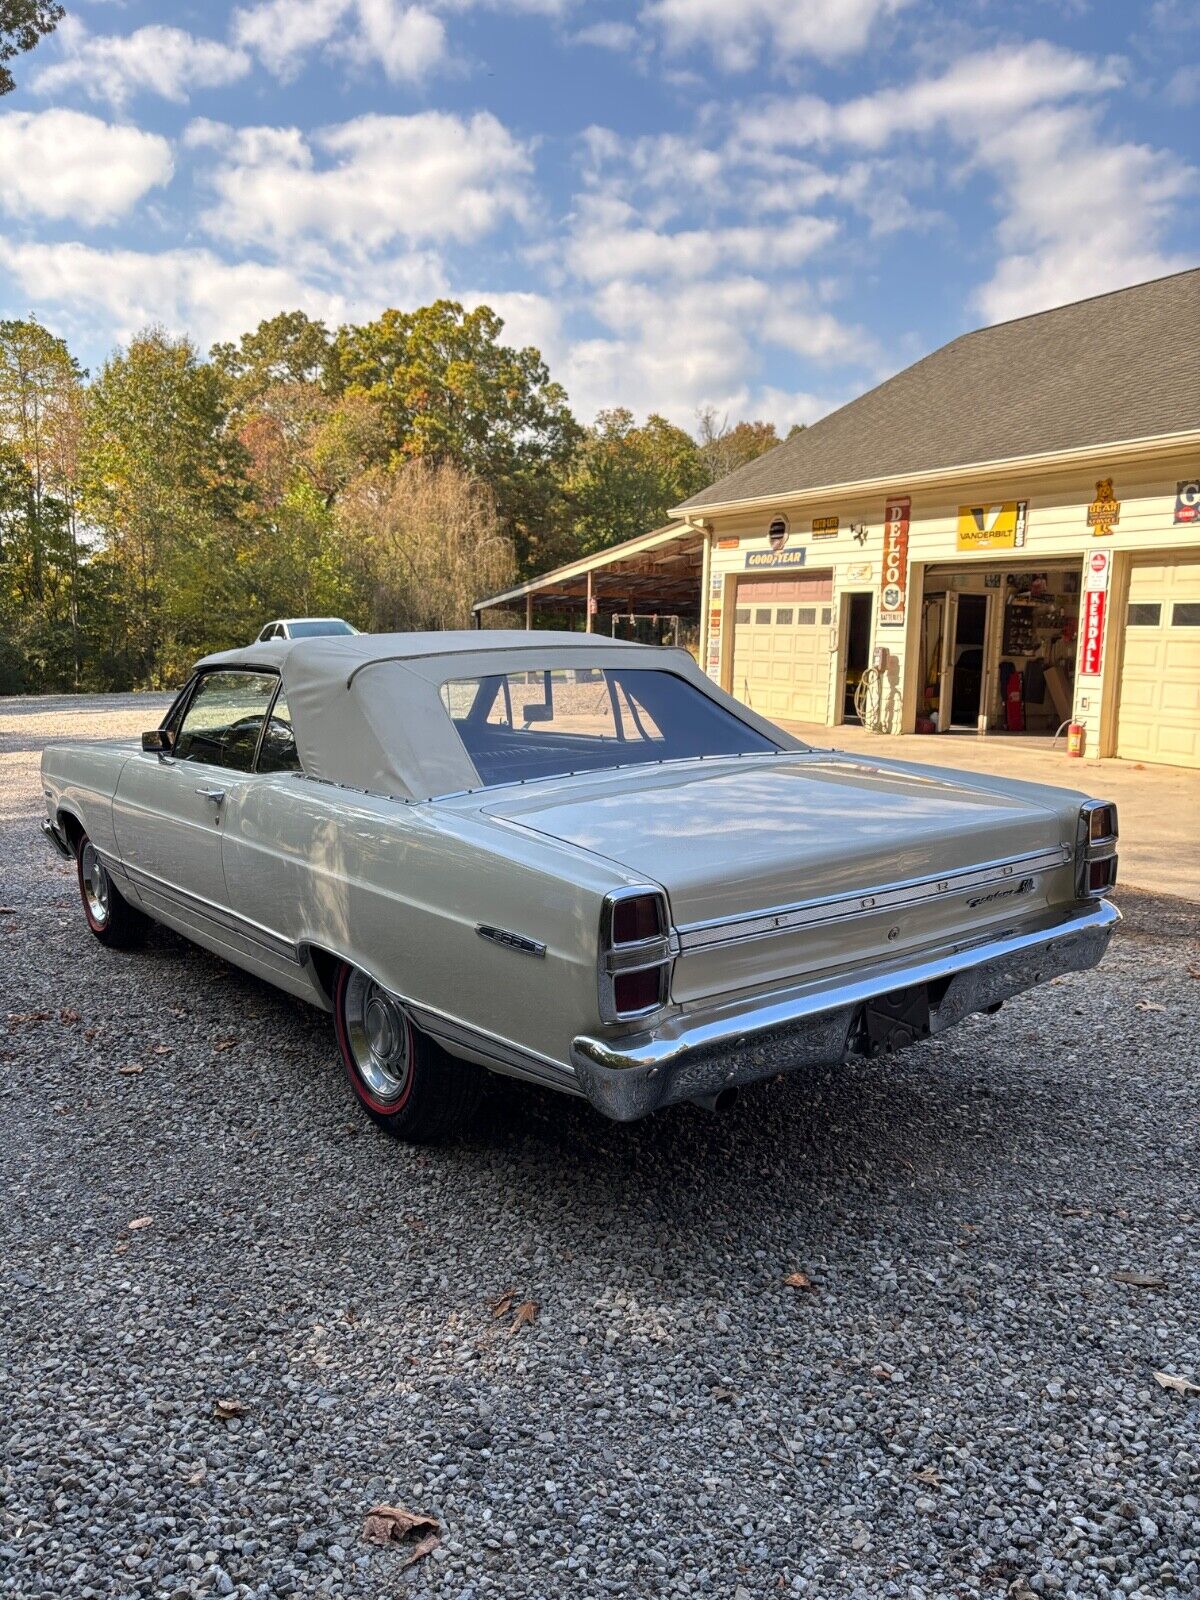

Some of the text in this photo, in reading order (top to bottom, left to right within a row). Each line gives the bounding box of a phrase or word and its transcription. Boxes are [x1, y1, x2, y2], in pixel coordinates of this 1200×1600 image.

[886, 506, 902, 583] DELCO
[960, 529, 1014, 541] VANDERBILT
[1014, 502, 1027, 547] TIRES
[1085, 592, 1100, 672] KENDALL
[773, 866, 1013, 927] FORD
